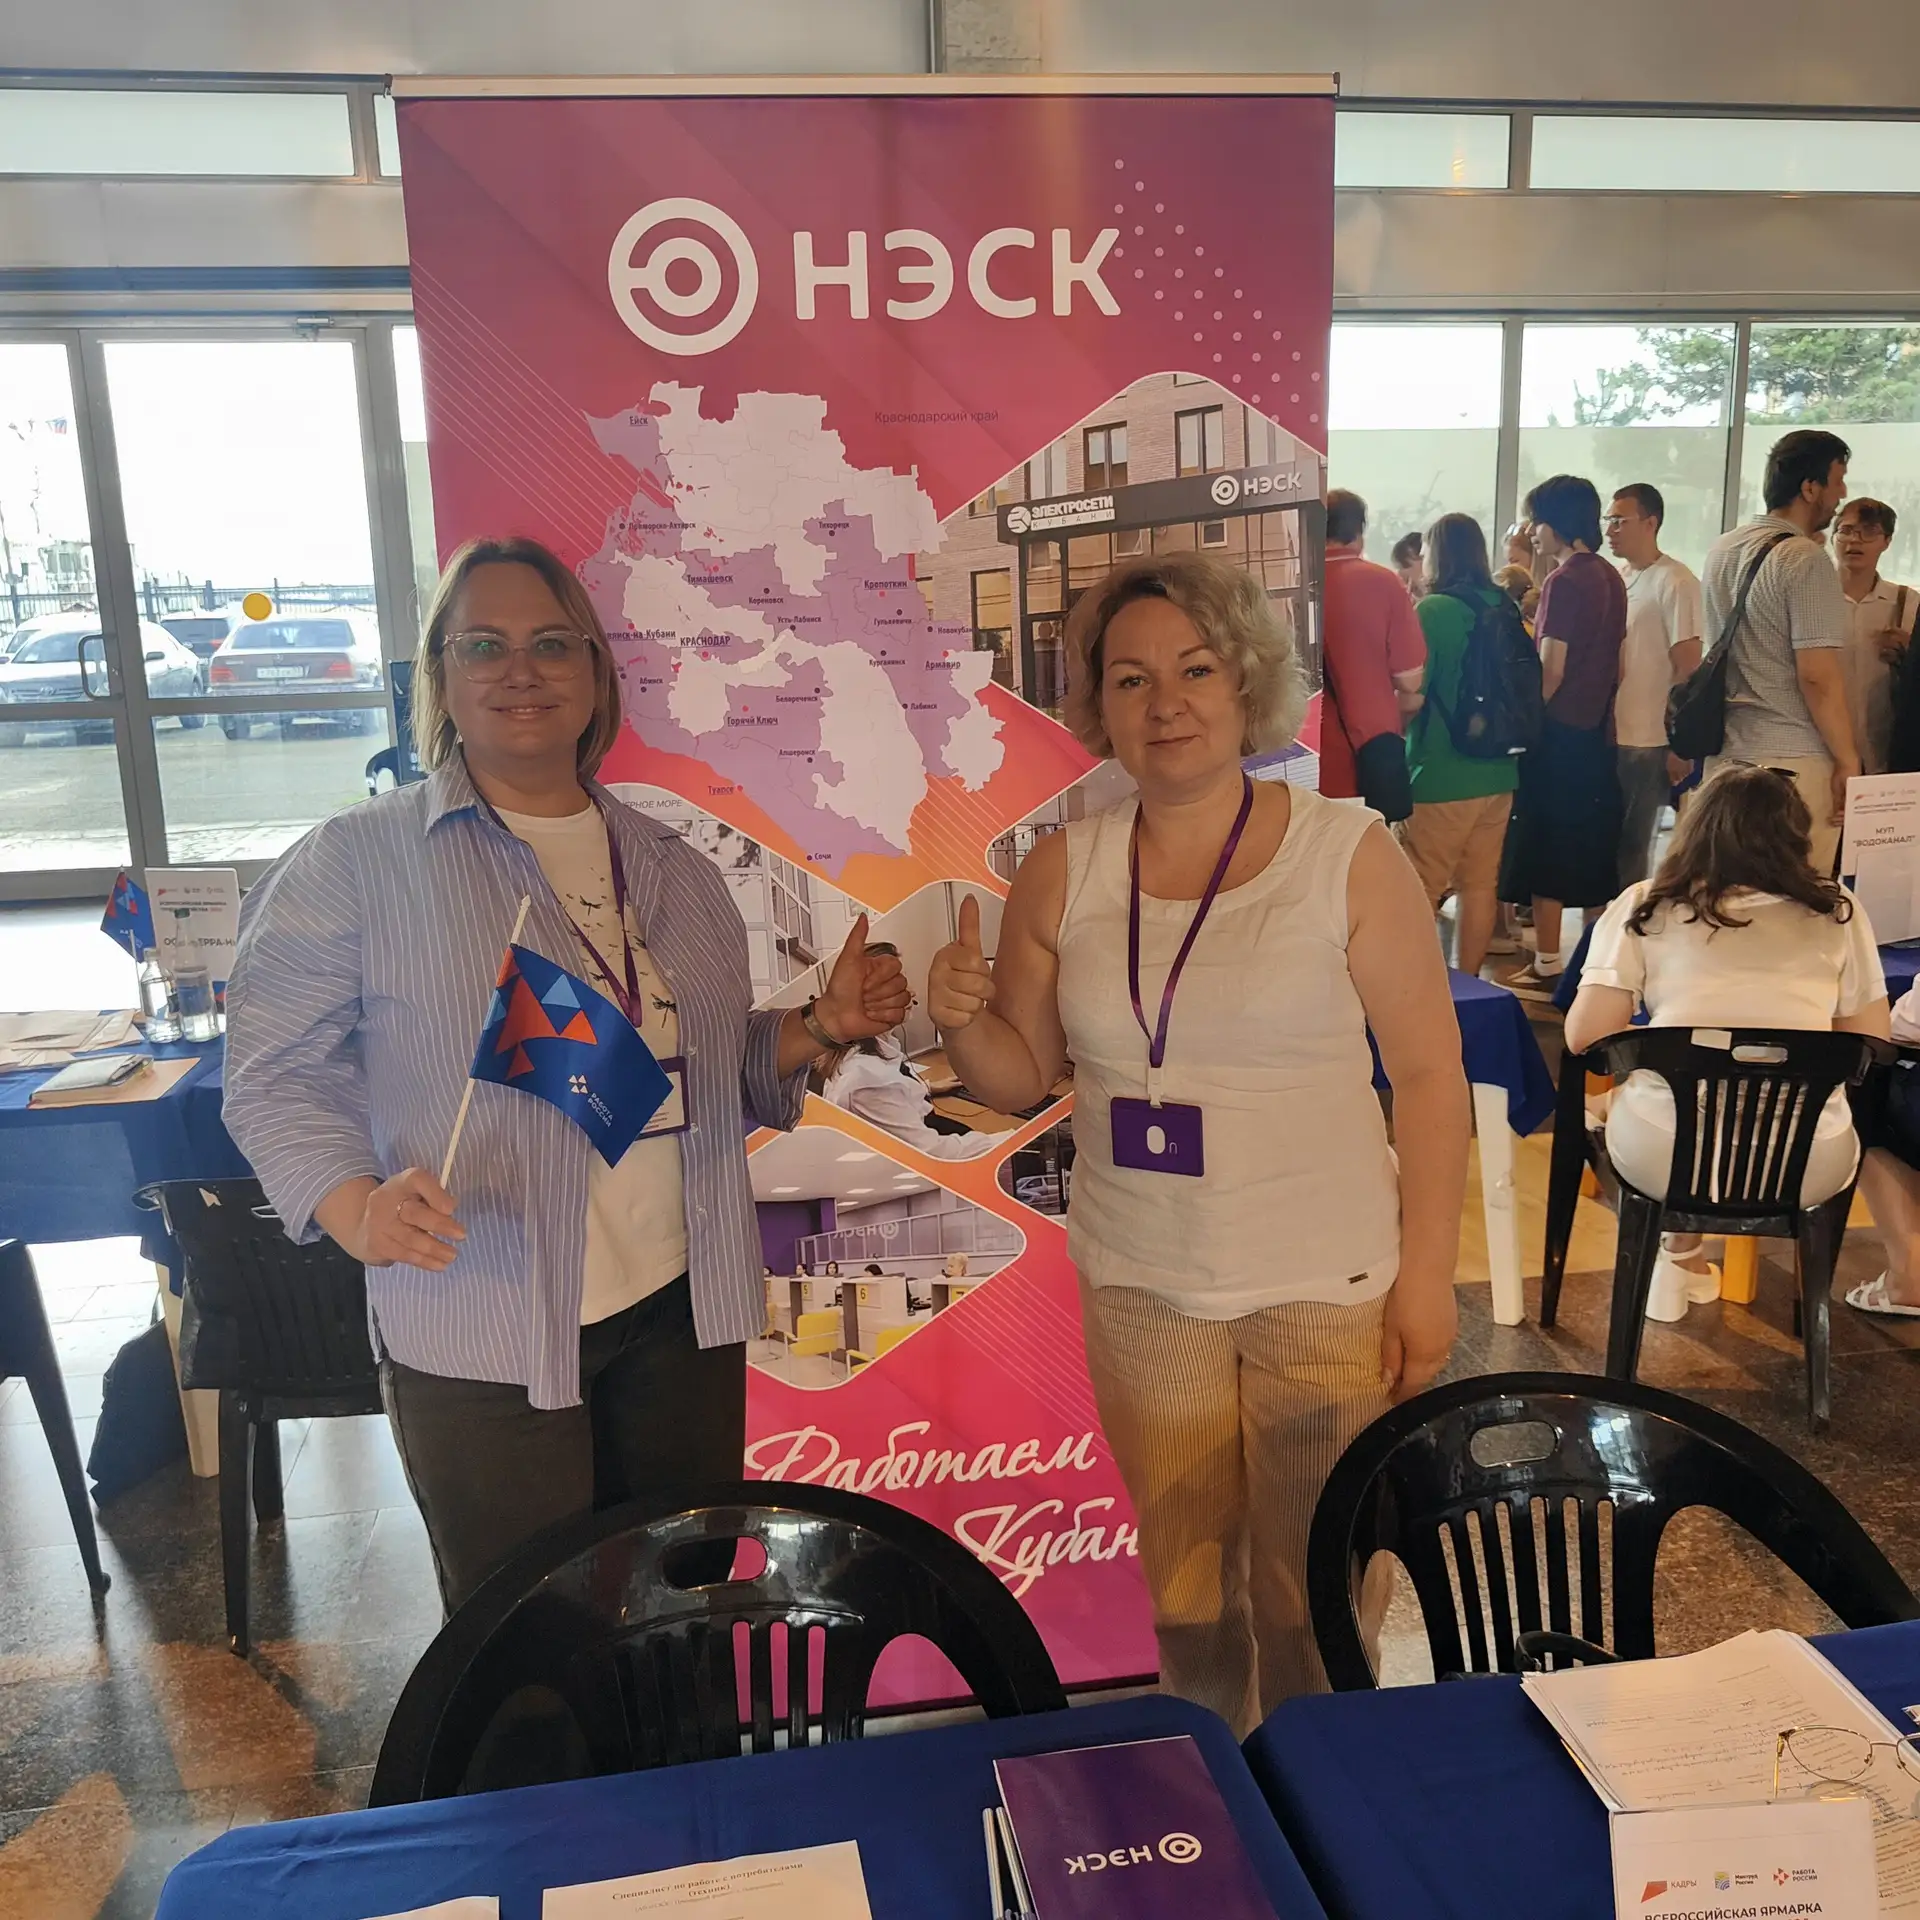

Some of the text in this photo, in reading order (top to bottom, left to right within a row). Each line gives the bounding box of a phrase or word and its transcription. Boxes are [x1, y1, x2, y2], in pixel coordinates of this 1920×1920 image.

[793, 228, 1122, 321] НЭСК
[629, 416, 648, 425] Ейск
[874, 409, 999, 424] Краснодарский край
[1244, 473, 1302, 496] НЭСК
[1031, 495, 1114, 519] ЭЛЕКТРОСЕТИ
[687, 574, 733, 584] Тимашевск
[864, 580, 907, 589] Кропоткин
[748, 597, 784, 605] Кореновск
[606, 629, 676, 640] вянск-на-Кубани
[680, 636, 731, 647] КРАСНОДАР
[925, 661, 961, 669] Армавир
[757, 716, 778, 725] Ключ
[622, 800, 683, 809] ЕРНОЕ МОРЕ
[1875, 827, 1895, 835] МУП
[815, 852, 832, 860] Сочи
[591, 1092, 613, 1121] РАБОТА
[587, 1098, 612, 1128] РОССИИ
[860, 1288, 867, 1300] 6
[744, 1421, 1097, 1494] Работаем
[954, 1497, 1139, 1599] Кубан
[1064, 1844, 1153, 1875] НЭСК
[1792, 1868, 1816, 1876] РАБОТА
[612, 1883, 671, 1900] Специалист
[674, 1879, 686, 1890] по
[688, 1877, 720, 1889] работе
[730, 1863, 803, 1881] потребителями
[1670, 1880, 1697, 1889] КАДРЫ
[688, 1883, 730, 1897] (техник)
[1760, 1902, 1823, 1917] ЯРМАРКА
